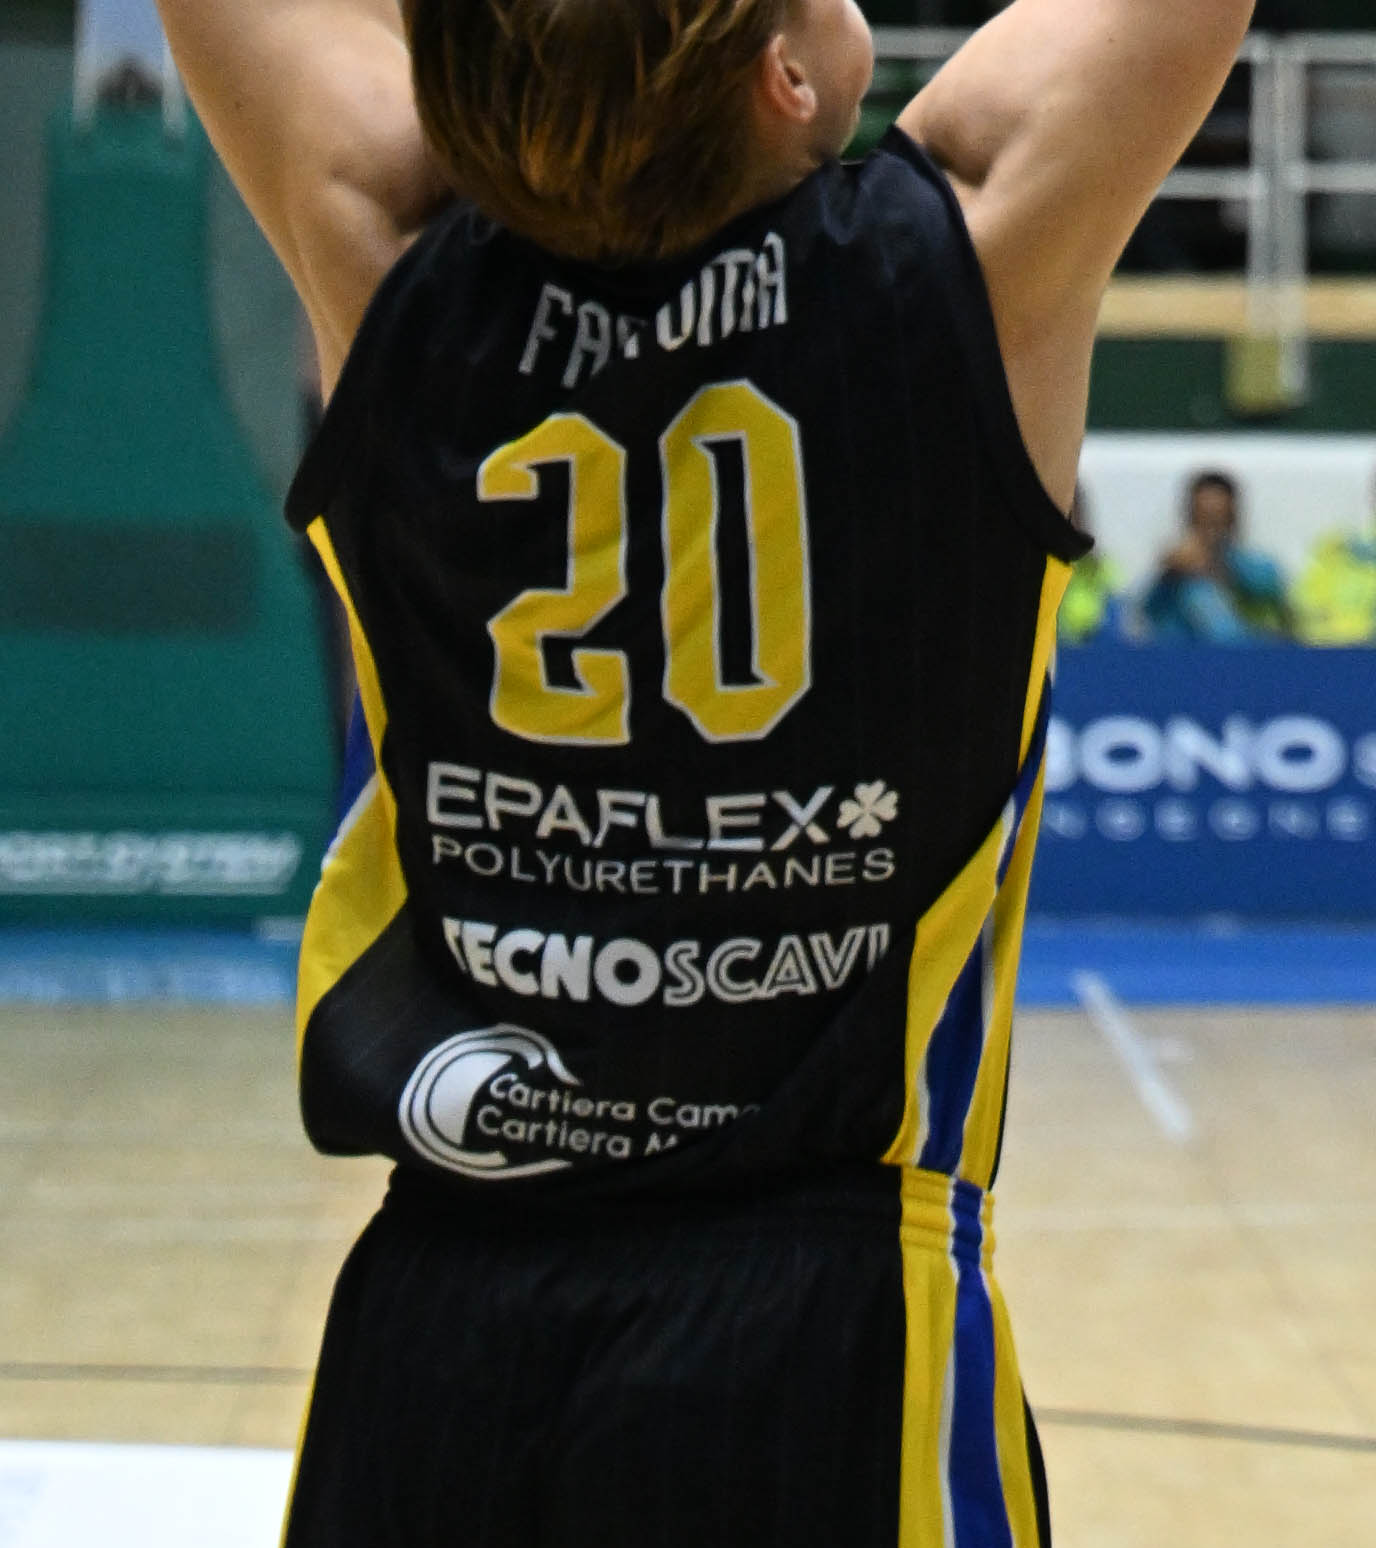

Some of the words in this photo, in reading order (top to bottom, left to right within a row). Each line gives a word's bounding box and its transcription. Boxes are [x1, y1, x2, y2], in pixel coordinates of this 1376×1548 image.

[476, 378, 812, 744] 20
[425, 760, 836, 851] EPAFLEX
[431, 834, 897, 895] POLYURETHANES
[476, 1103, 632, 1159] Cartiera
[489, 1072, 636, 1122] Cartiera
[647, 1095, 761, 1129] Cam
